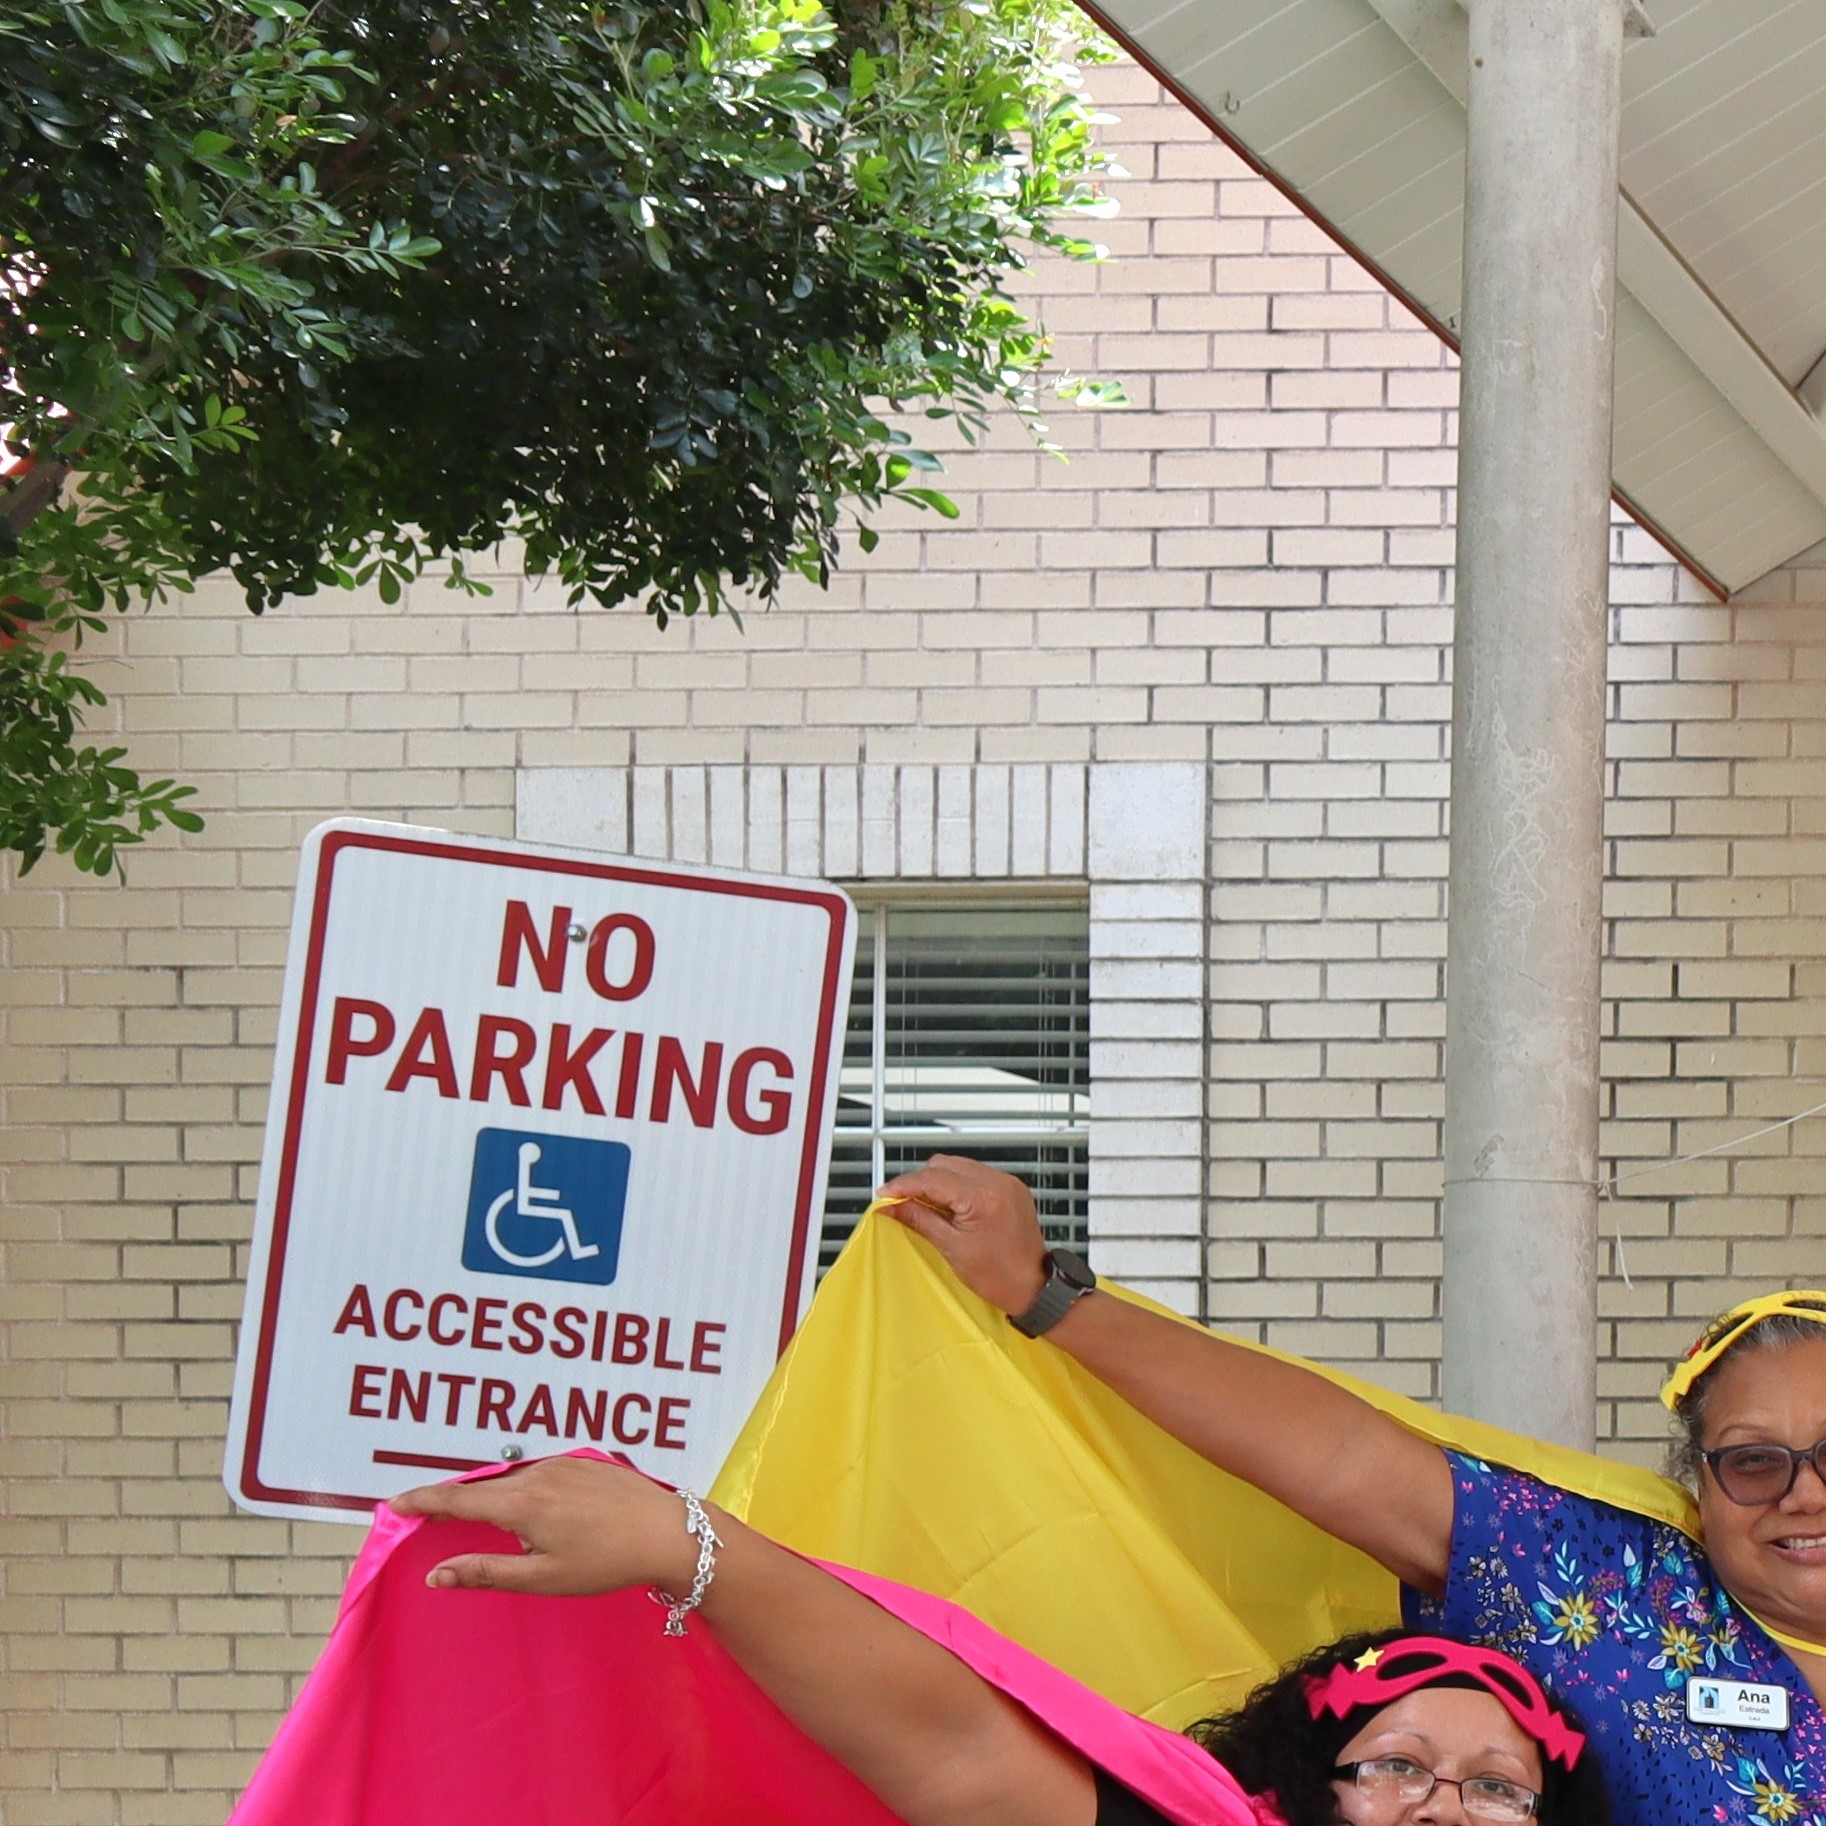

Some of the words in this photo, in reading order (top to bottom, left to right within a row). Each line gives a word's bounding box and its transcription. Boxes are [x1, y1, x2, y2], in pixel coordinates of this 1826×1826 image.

[496, 899, 656, 1002] NO
[325, 996, 795, 1136] PARKING
[333, 1283, 727, 1375] ACCESSIBLE
[348, 1364, 691, 1450] ENTRANCE
[1737, 1688, 1771, 1705] Ana
